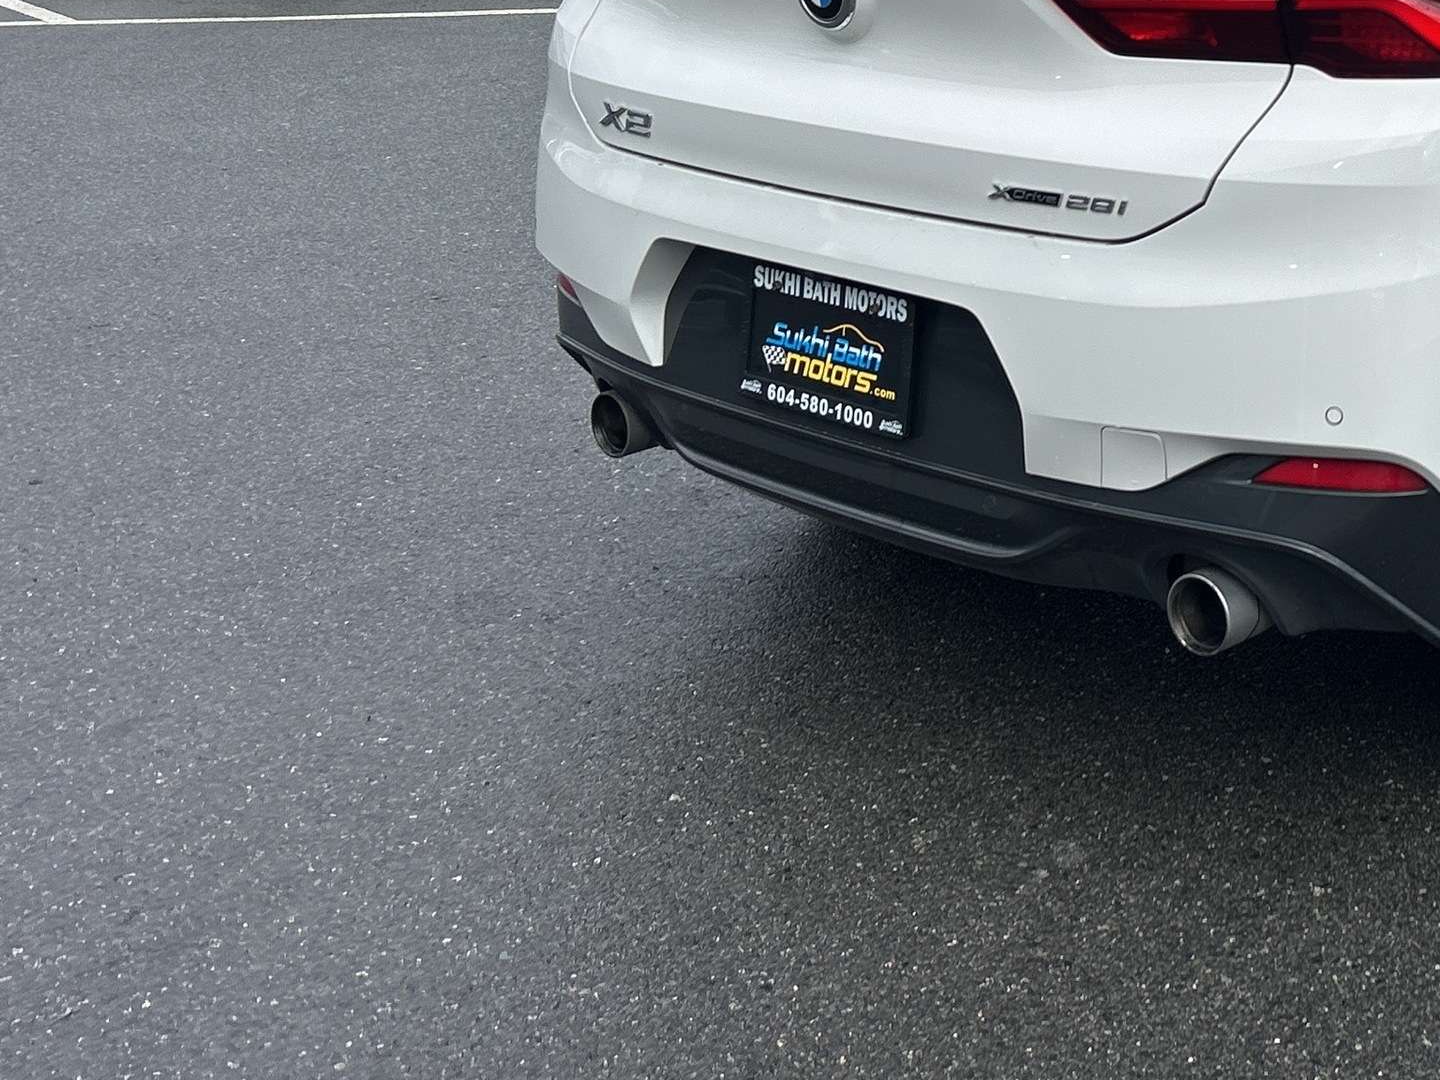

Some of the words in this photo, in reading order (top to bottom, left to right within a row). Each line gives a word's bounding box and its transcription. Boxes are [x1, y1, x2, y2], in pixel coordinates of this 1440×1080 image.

[599, 101, 653, 139] X2
[753, 264, 800, 298] SUKHI
[803, 276, 841, 307] BATH
[844, 285, 908, 323] MOTORS
[766, 321, 831, 358] Sukhi
[832, 336, 883, 371] Bath
[766, 383, 874, 430] 604-580-1000
